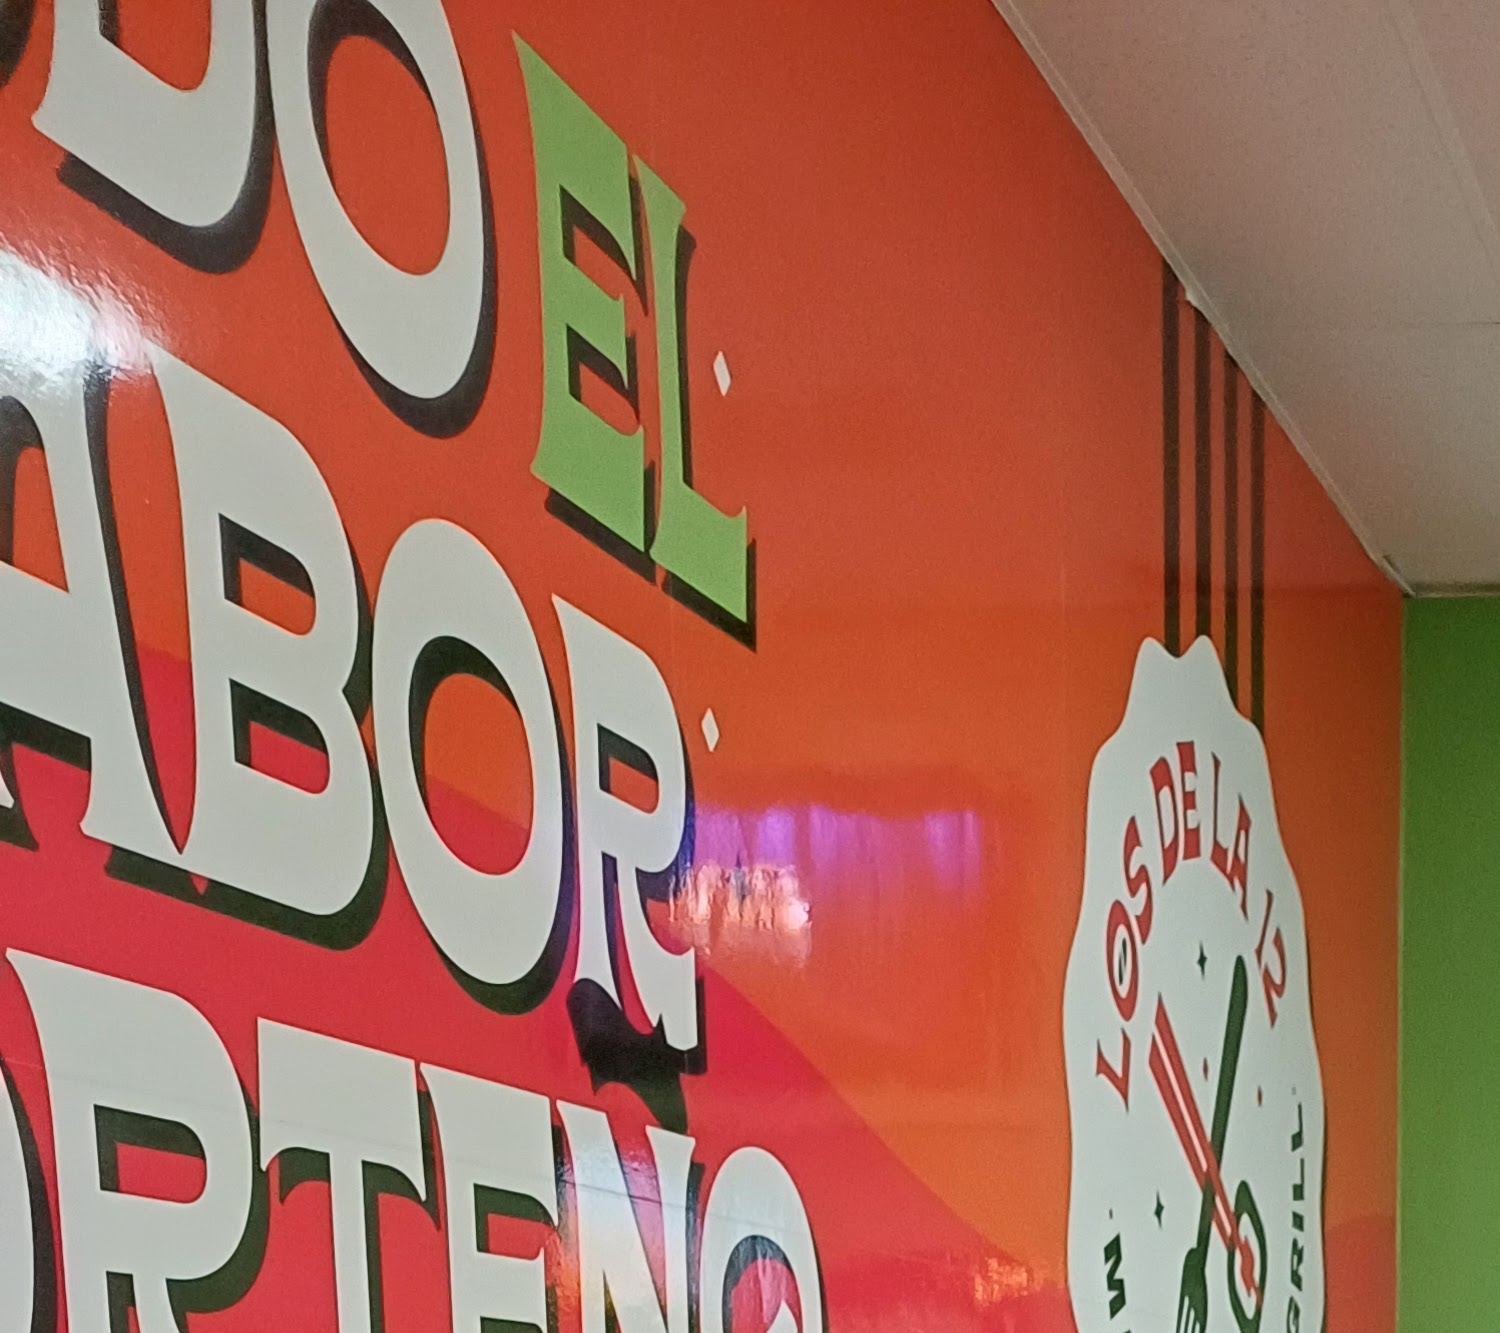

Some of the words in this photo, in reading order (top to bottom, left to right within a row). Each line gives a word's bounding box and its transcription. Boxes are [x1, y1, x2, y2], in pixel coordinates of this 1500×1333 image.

[512, 30, 755, 645] EL
[1095, 815, 1153, 1113] LOS
[1150, 739, 1201, 886] DE
[1210, 750, 1252, 921] LA
